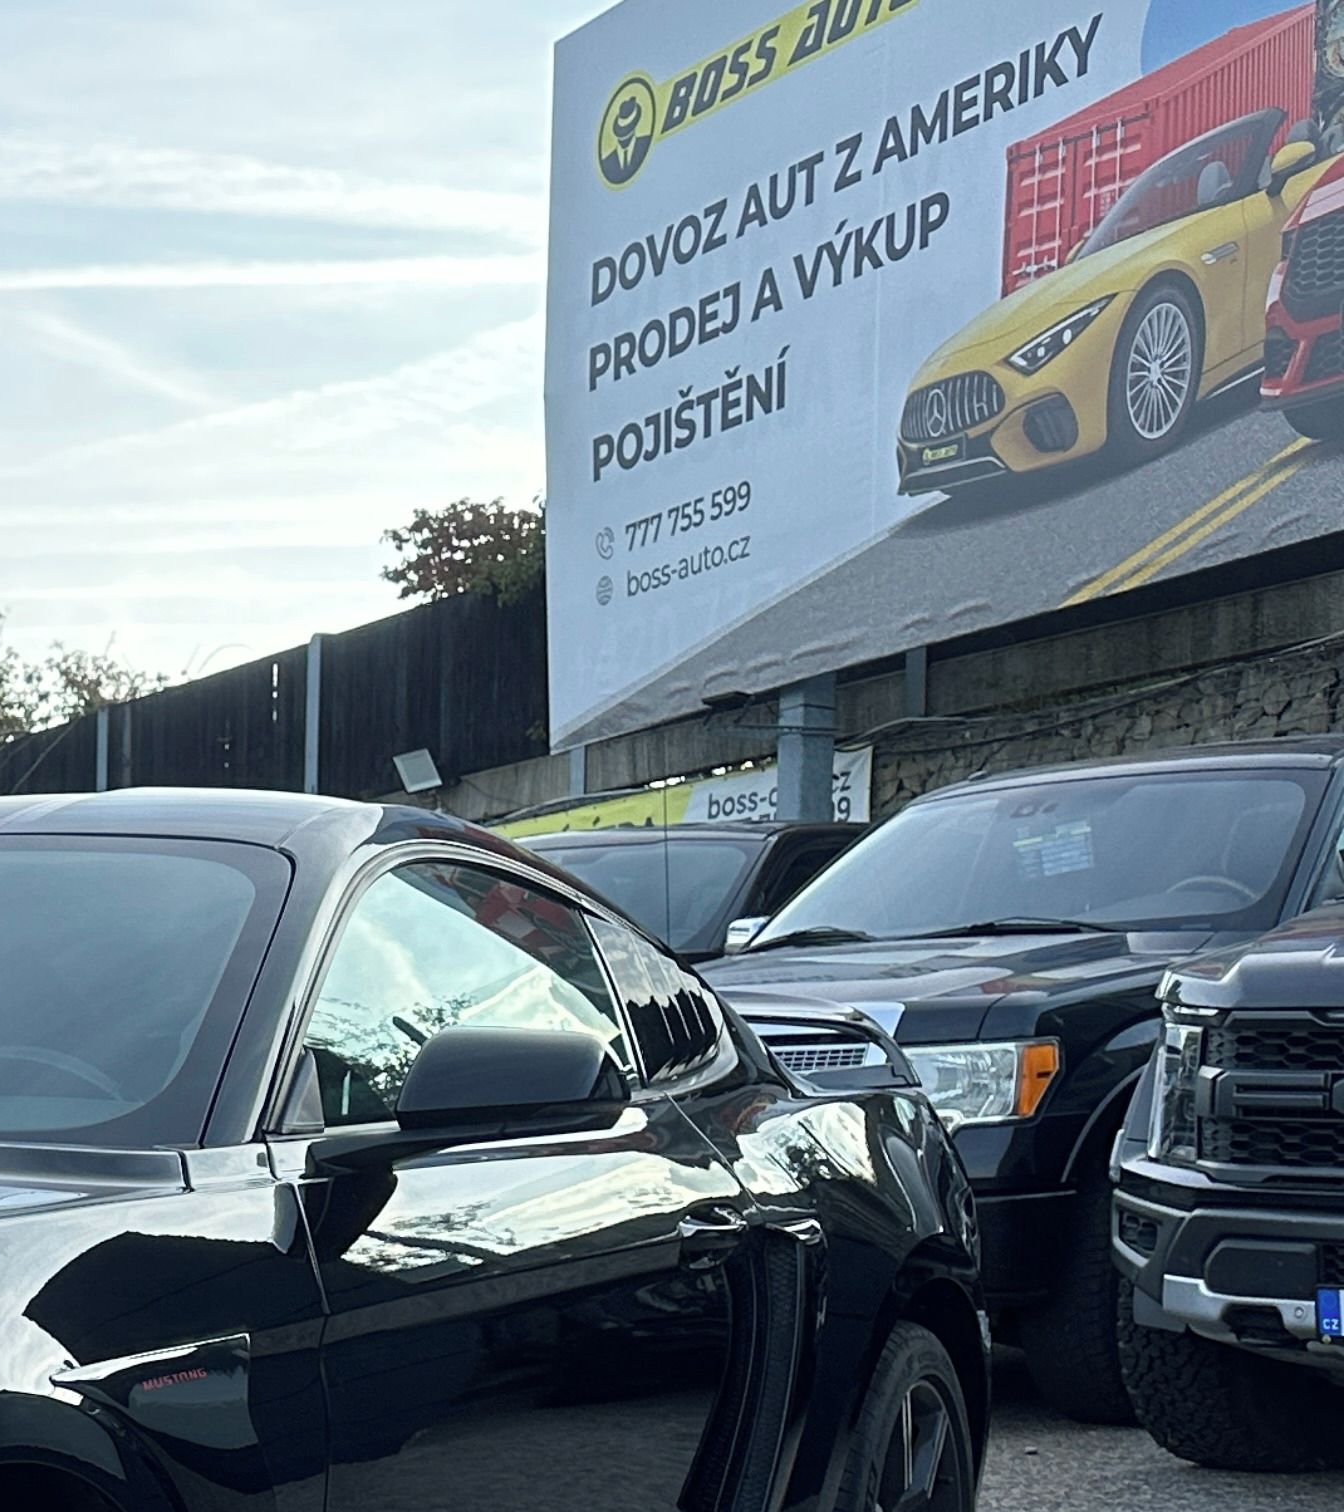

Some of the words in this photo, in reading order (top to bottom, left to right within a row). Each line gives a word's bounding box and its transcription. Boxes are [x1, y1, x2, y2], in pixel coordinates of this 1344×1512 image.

[660, 24, 781, 135] BOSS
[591, 197, 728, 307] DOVOZ
[735, 150, 825, 239] AUT
[833, 131, 864, 193] Z
[872, 13, 1104, 175] AMERIKY
[588, 281, 741, 393] PRODEJ
[750, 267, 784, 322] A
[792, 191, 950, 300] VÝKUP
[592, 344, 791, 483] POJIŠTĚNÍ
[624, 512, 663, 552] 777
[667, 497, 705, 537] 755
[710, 480, 752, 521] 599
[627, 535, 751, 597] boss-auto.cz
[1322, 1318, 1340, 1330] CZ
[141, 1367, 209, 1392] MUSTANG
